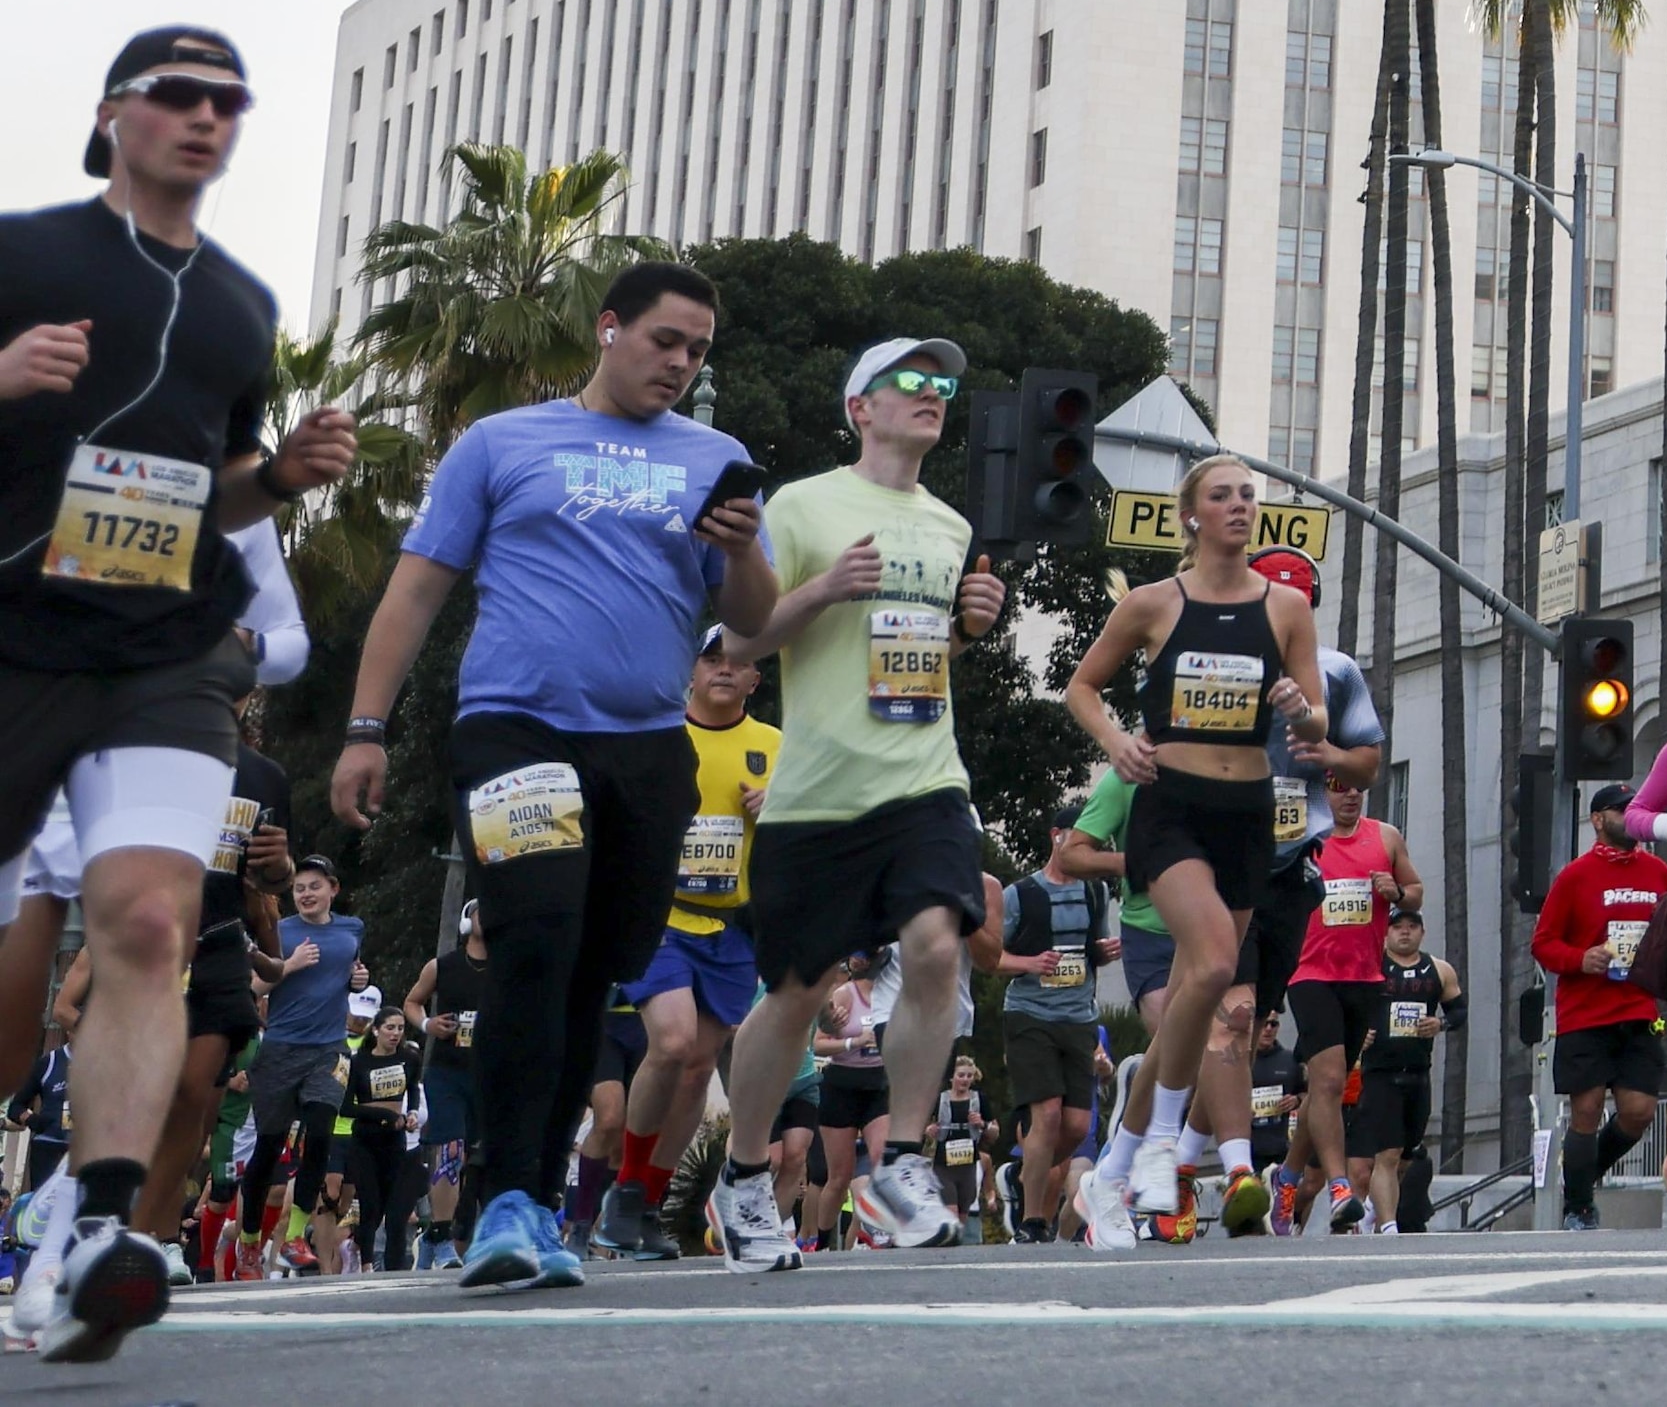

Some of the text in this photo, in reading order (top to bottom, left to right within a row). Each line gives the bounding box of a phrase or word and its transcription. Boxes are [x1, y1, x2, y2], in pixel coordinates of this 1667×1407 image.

[596, 442, 647, 459] TEAM
[554, 453, 687, 504] TMF
[84, 511, 180, 556] 11732
[1130, 501, 1309, 548] PE NG
[881, 651, 942, 674] 12862
[1184, 690, 1248, 710] 18404
[508, 802, 553, 824] AIDAN
[1279, 808, 1299, 825] 63
[510, 822, 555, 839] A10571
[682, 844, 735, 859] E8700
[1394, 1018, 1420, 1028] E024
